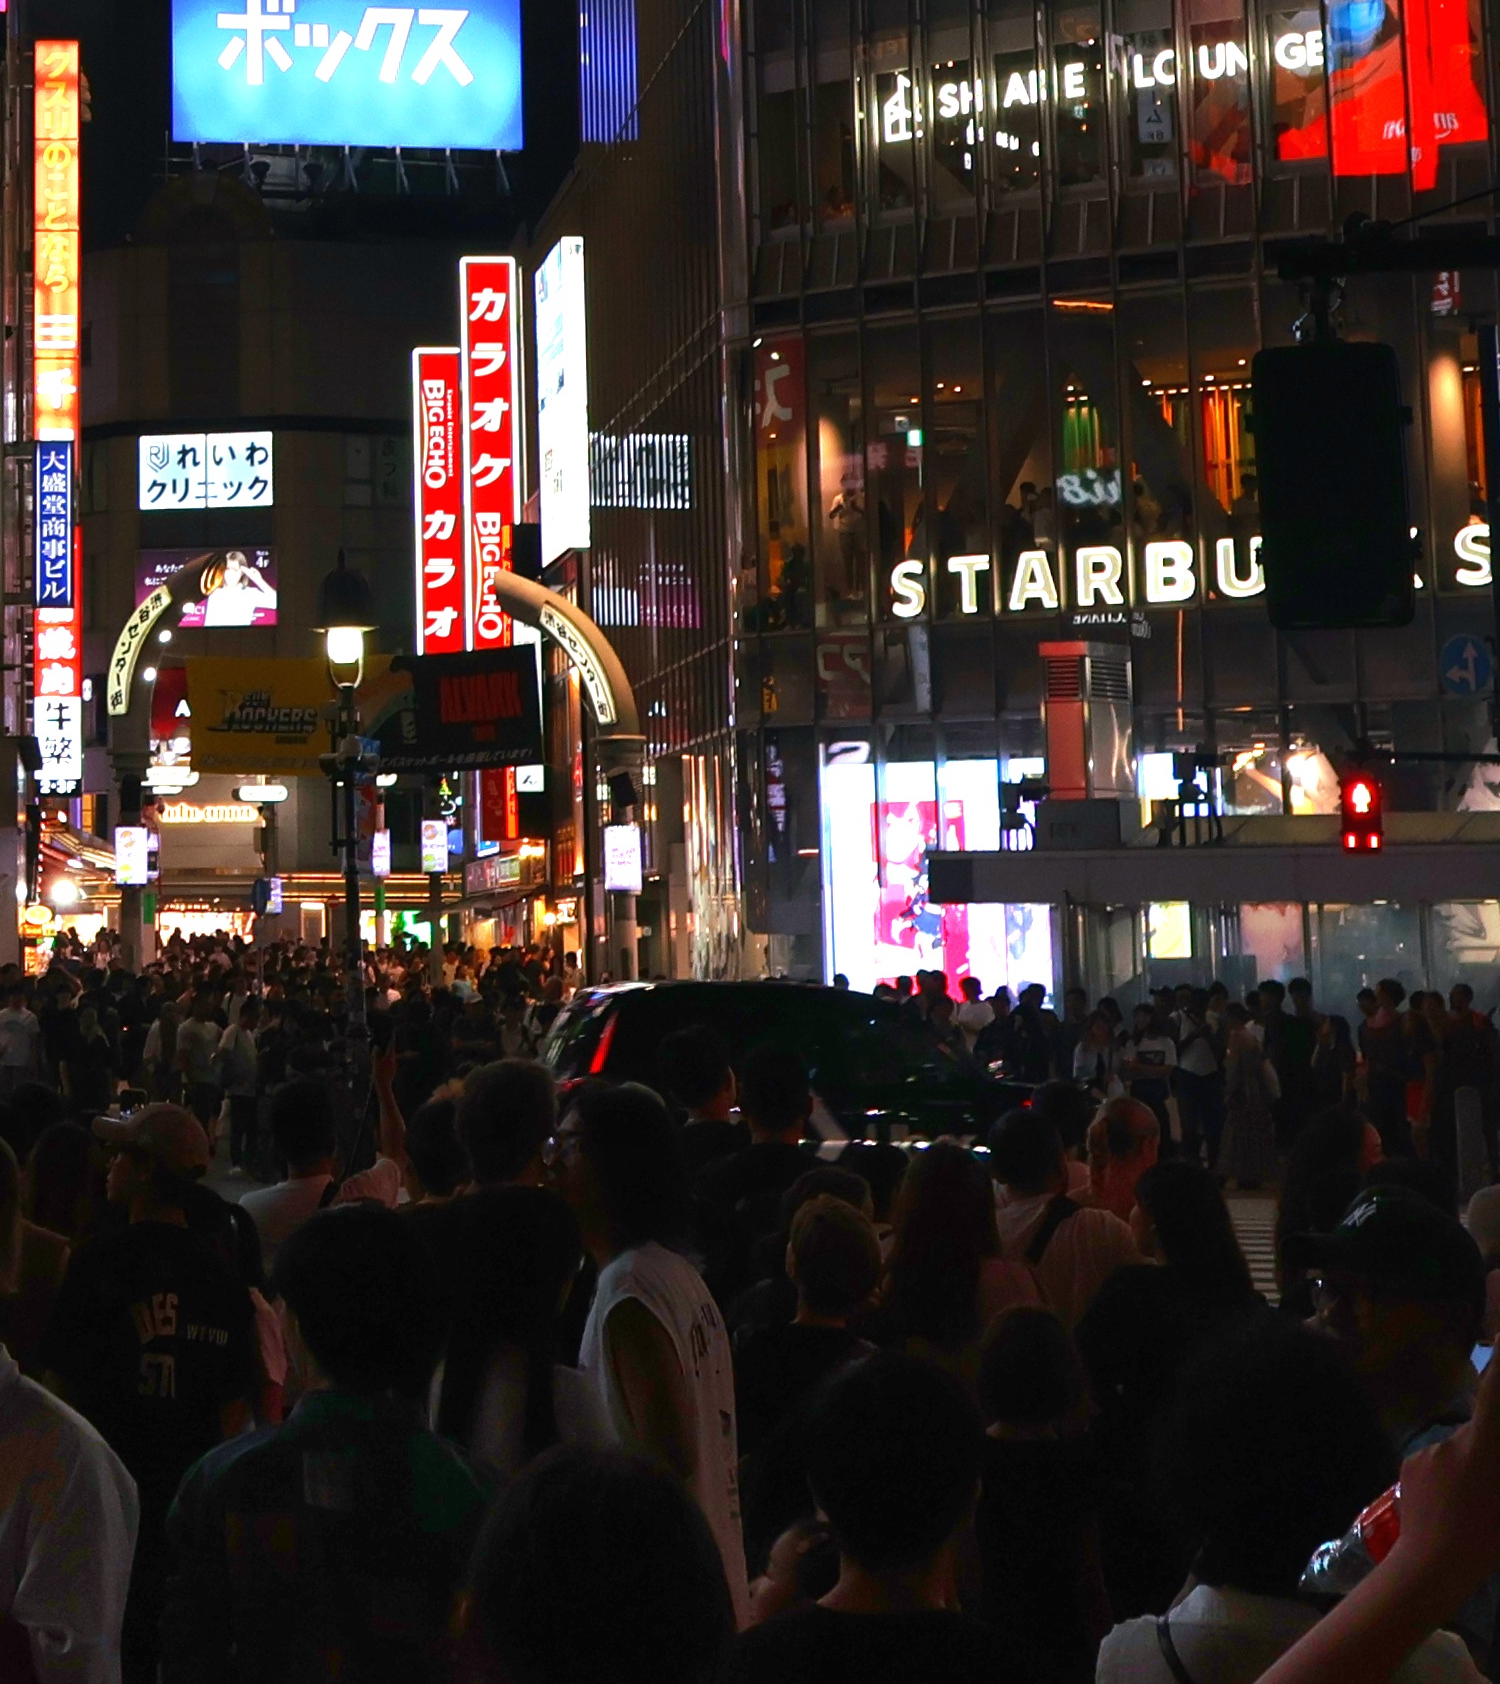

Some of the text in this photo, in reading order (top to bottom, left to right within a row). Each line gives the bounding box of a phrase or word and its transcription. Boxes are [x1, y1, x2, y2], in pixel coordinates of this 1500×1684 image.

[423, 379, 447, 489] BIG ECHO
[469, 288, 512, 488] カラオケ
[147, 475, 269, 504] クリニック
[177, 441, 269, 469] れいわ
[41, 449, 67, 600] 大盛堂商事ビル
[422, 511, 457, 638] カラオ
[476, 512, 502, 563] BIG
[890, 523, 1493, 618] STARBUS
[110, 590, 166, 710] 渋谷センター街
